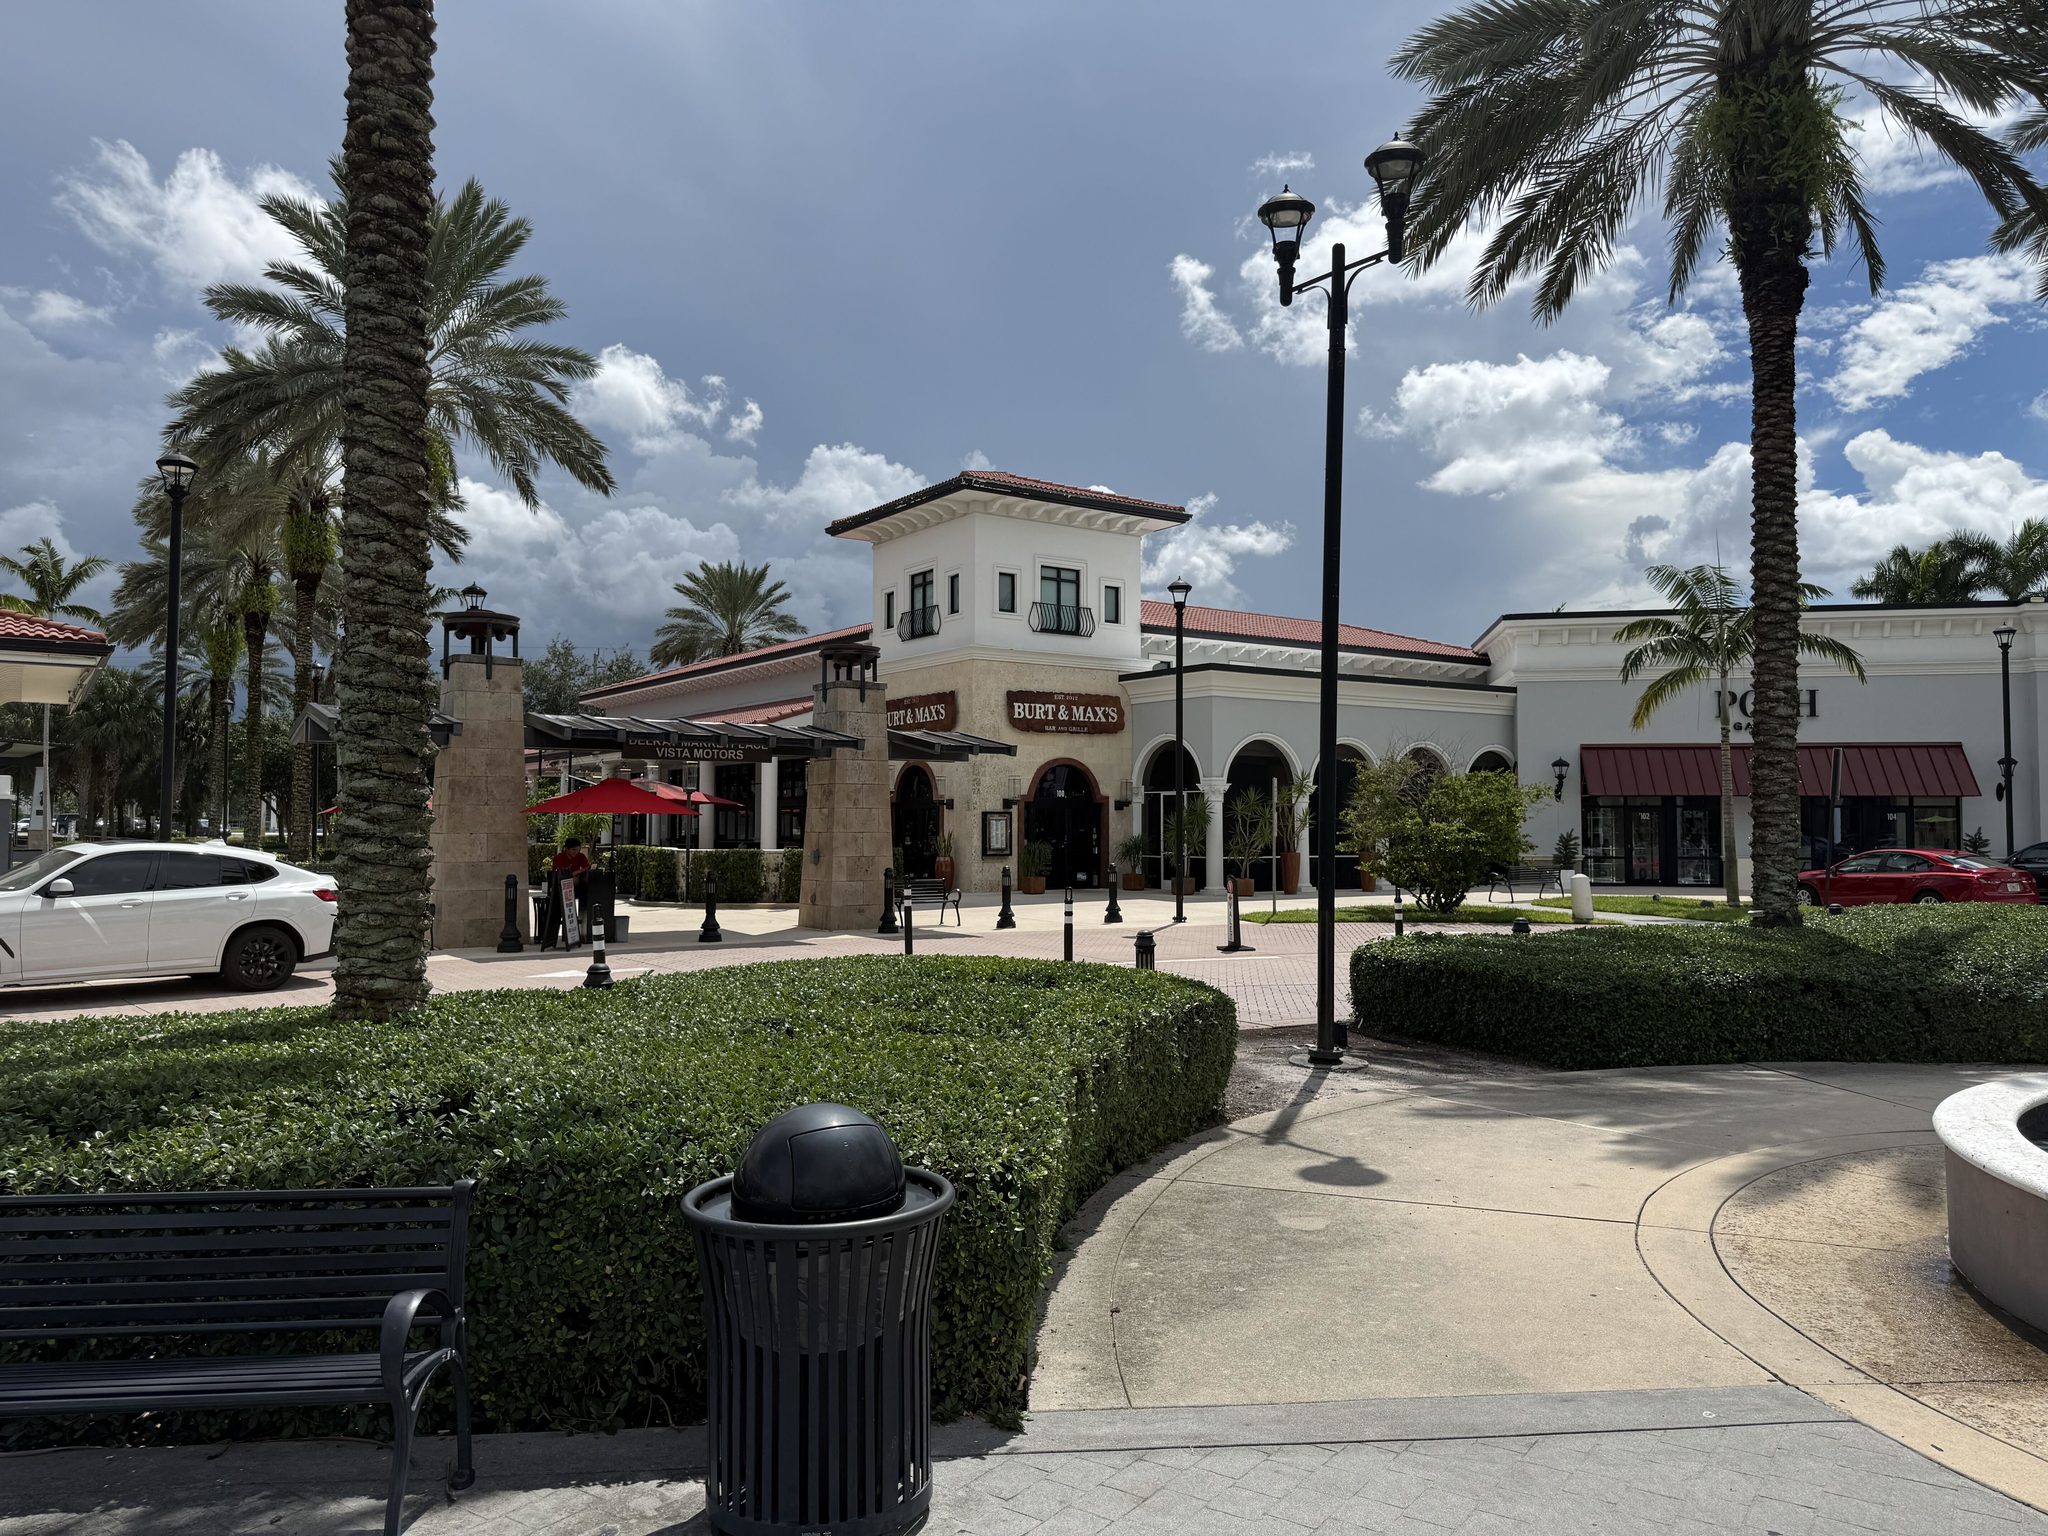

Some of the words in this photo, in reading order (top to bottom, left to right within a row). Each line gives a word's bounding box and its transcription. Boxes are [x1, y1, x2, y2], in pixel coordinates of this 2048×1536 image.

[1713, 689, 1820, 718] POH
[887, 709, 906, 727] URT
[906, 708, 914, 724] &
[915, 703, 946, 723] MAX'S
[1013, 702, 1056, 720] BURT
[1058, 704, 1069, 721] &
[1071, 705, 1118, 723] MAX'S
[656, 747, 691, 759] VISTA
[693, 748, 744, 760] MOTORS
[1638, 812, 1650, 820] 102
[1887, 813, 1897, 821] 104
